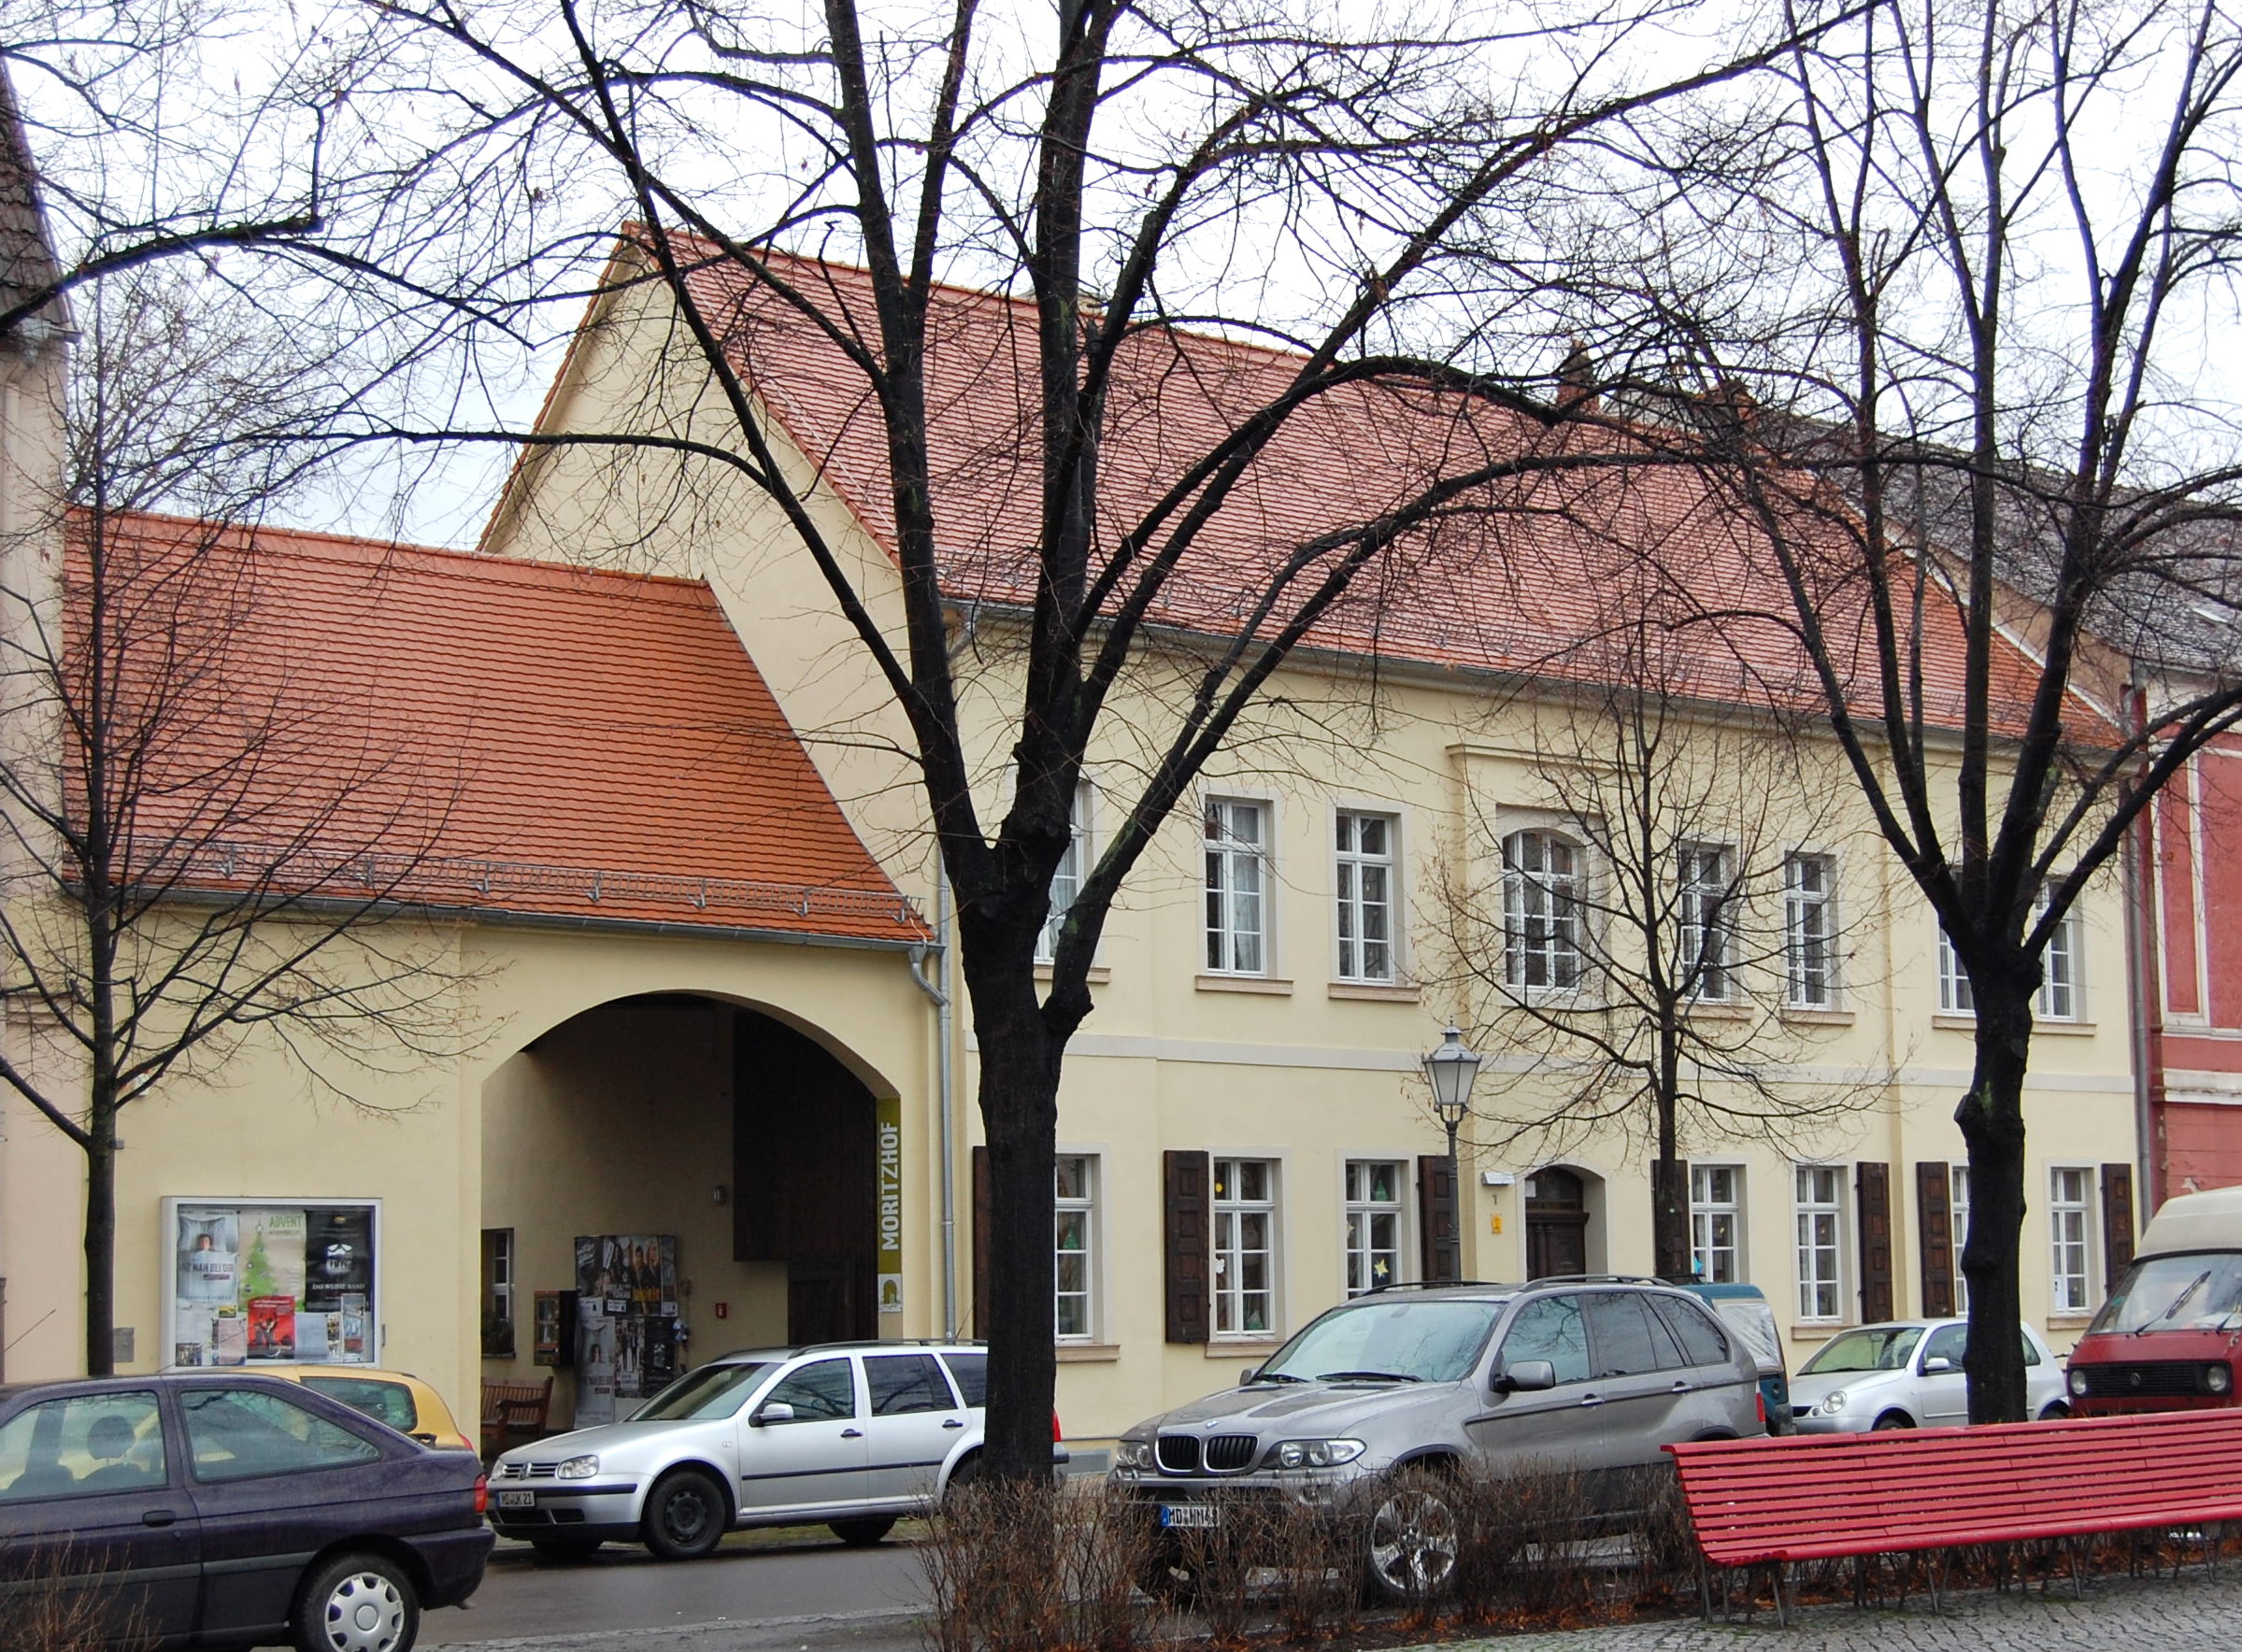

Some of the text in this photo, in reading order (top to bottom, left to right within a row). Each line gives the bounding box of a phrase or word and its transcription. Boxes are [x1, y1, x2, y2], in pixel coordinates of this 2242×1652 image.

[880, 1121, 899, 1251] MORITZHOF
[268, 1215, 303, 1228] ADVENT
[193, 1263, 208, 1272] NAH
